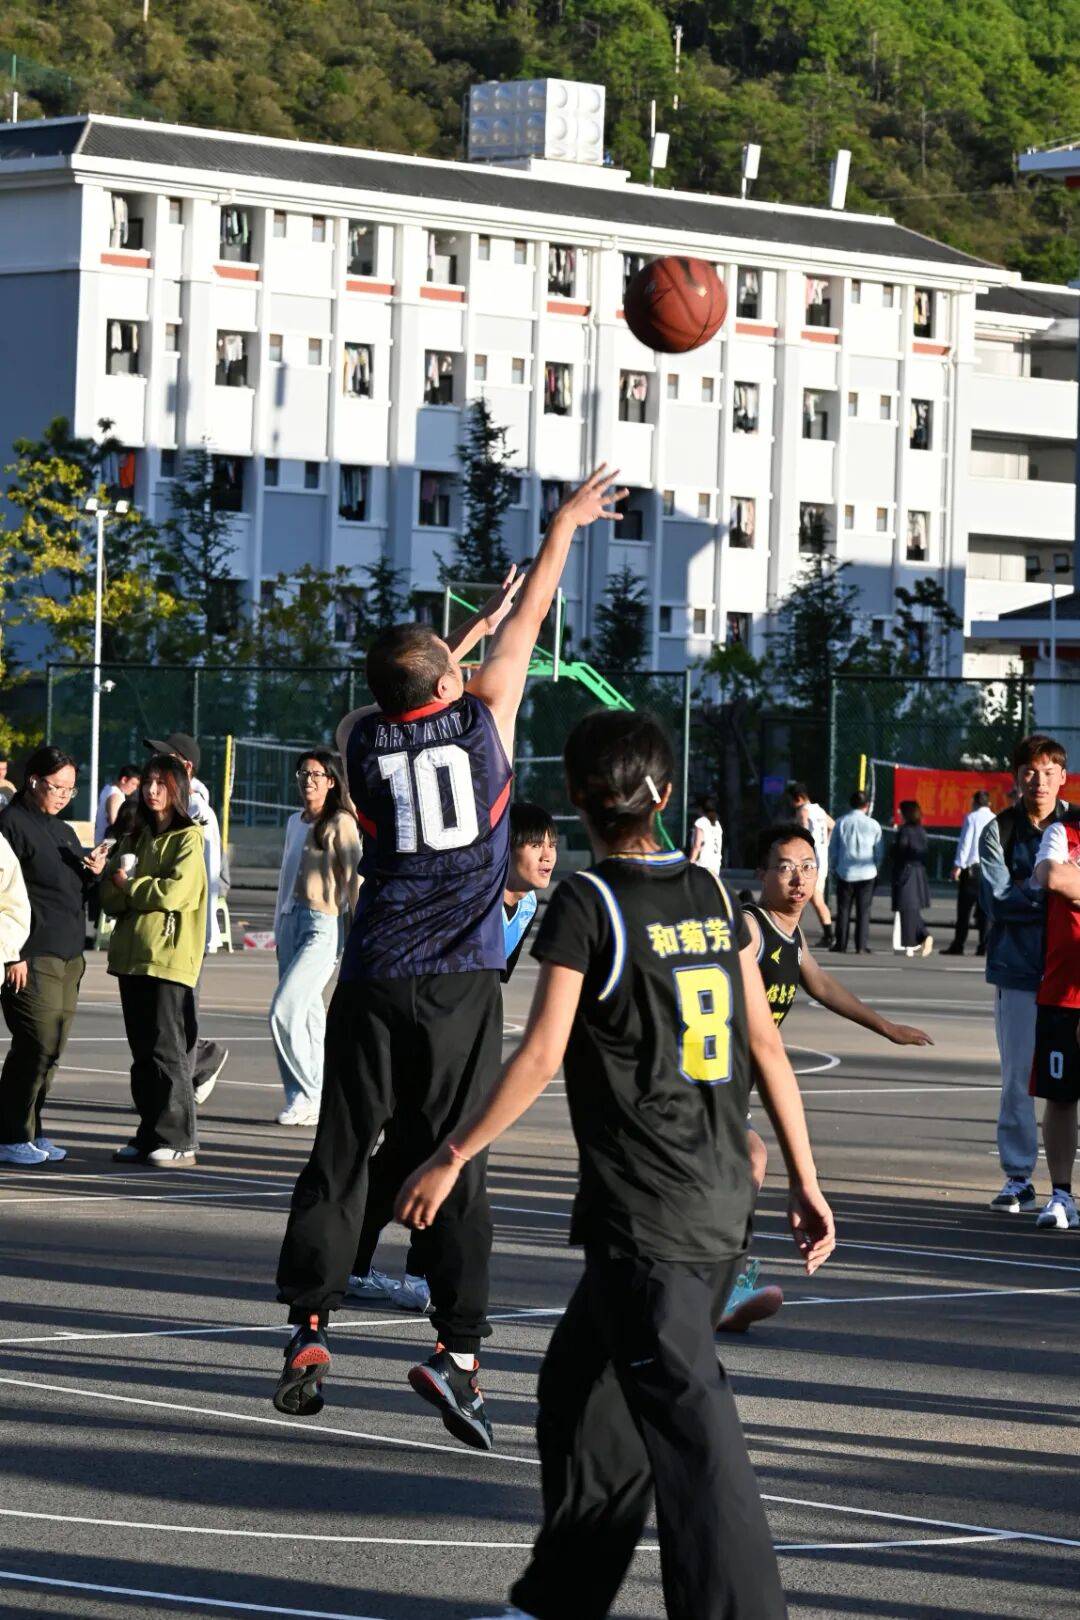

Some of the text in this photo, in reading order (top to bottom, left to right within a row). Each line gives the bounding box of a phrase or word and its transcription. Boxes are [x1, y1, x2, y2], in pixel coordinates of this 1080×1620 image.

[374, 712, 463, 748] BRYANT
[377, 744, 479, 852] 10
[647, 918, 732, 958] 和菊芳
[672, 963, 734, 1085] 8
[1050, 1051, 1063, 1080] 0
